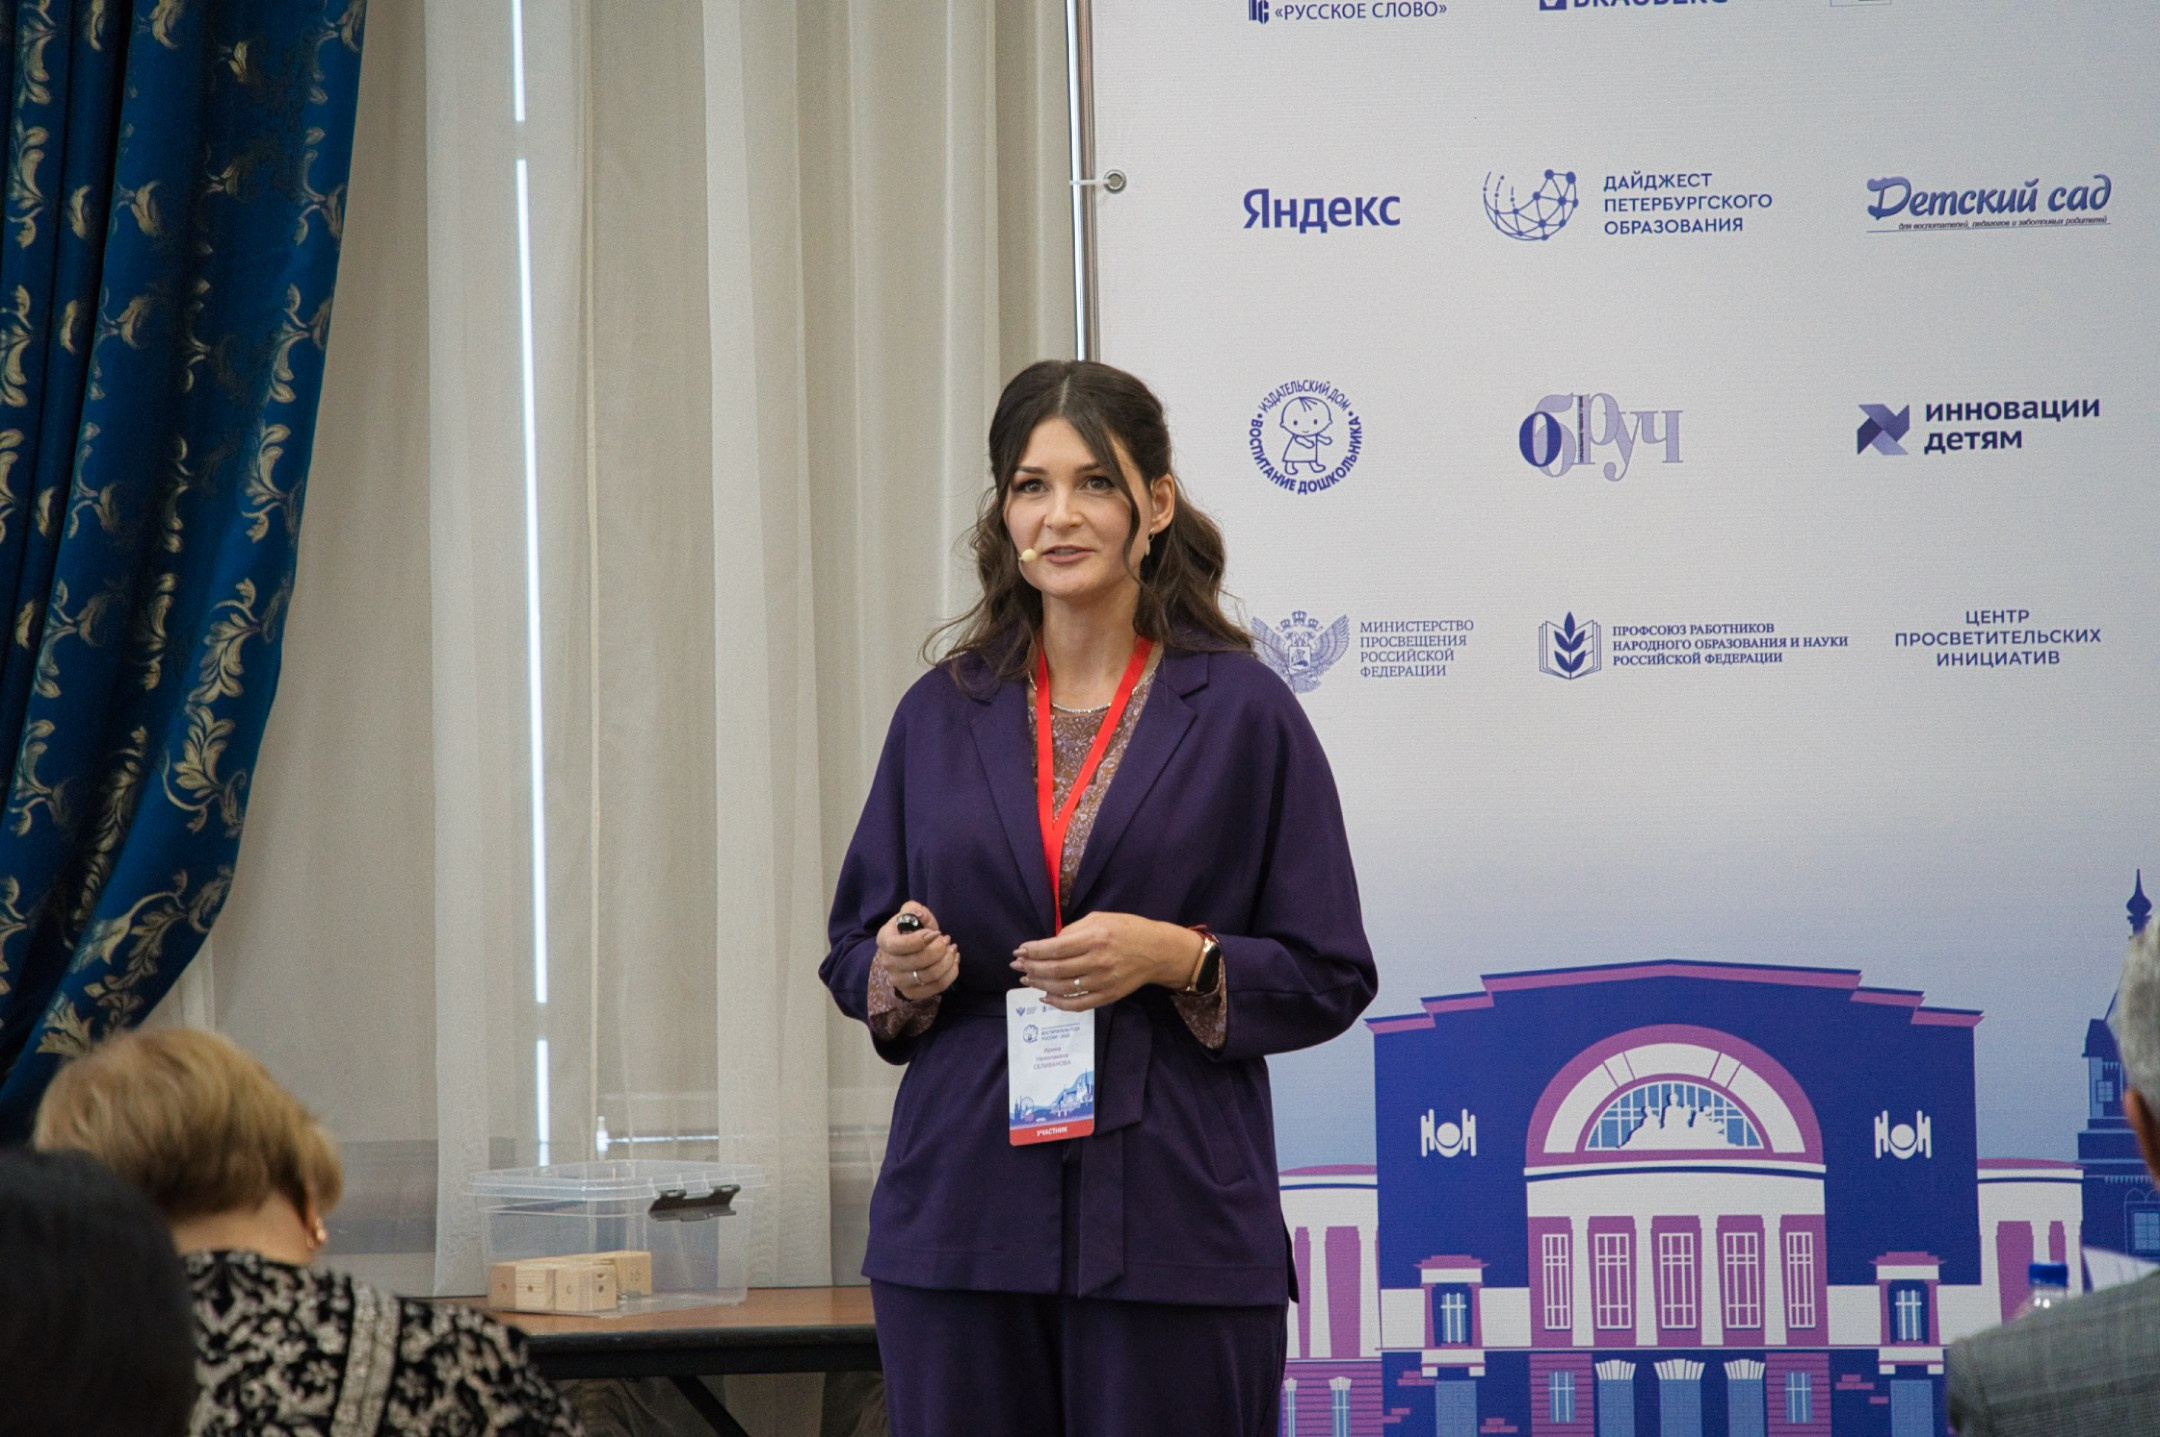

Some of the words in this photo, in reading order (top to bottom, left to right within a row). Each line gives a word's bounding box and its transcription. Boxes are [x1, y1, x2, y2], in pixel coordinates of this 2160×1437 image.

[1275, 3, 1366, 20] «РУССКОЕ
[1372, 1, 1447, 18] СЛОВО»
[1604, 171, 1712, 192] ДАЙДЖЕСТ
[1605, 194, 1772, 212] ПЕТЕРБУРГСКОГО
[1867, 176, 2040, 221] Детский
[2048, 174, 2111, 212] сад
[1244, 189, 1400, 234] Яндекс
[1605, 217, 1743, 235] ОБРАЗОВАНИЯ
[1258, 379, 1331, 413] ИЗДАТЕЛЬСКИЙ
[1327, 388, 1352, 411] ДОМ
[1926, 399, 2099, 422] инновации
[1924, 431, 2022, 455] детям
[1249, 419, 1297, 491] ВОСПИТАНИЕ
[1297, 416, 1363, 495] ДОШКОЛЬНИКА
[1360, 620, 1474, 633] МИНИСТЕРСТВО
[1966, 610, 2029, 626] ЦЕНТР
[1613, 625, 1686, 636] ПРОФСОЮЗ
[1690, 623, 1774, 635] РАБОТНИКОВ
[1896, 629, 2101, 646] ПРОСВЕТИТЕЛЬСКИХ
[1360, 635, 1467, 649] ПРОСВЕЩЕНИЯ
[1613, 639, 1691, 652] НАРОДНОГО
[1695, 638, 1787, 649] ОБРАЗОВАНИЯ
[1791, 637, 1799, 647] И
[1803, 636, 1848, 647] НАУКИ
[1360, 648, 1454, 663] РОССИЙСКОЙ
[1613, 652, 1701, 666] РОССИЙСКОЙ
[1705, 653, 1782, 665] ФЕДЕРАЦИИ
[1937, 651, 2060, 668] ИНИЦИАТИВ
[1360, 663, 1446, 679] ФЕДЕРАЦИИ
[1036, 1126, 1068, 1137] УЧАСТНИК
